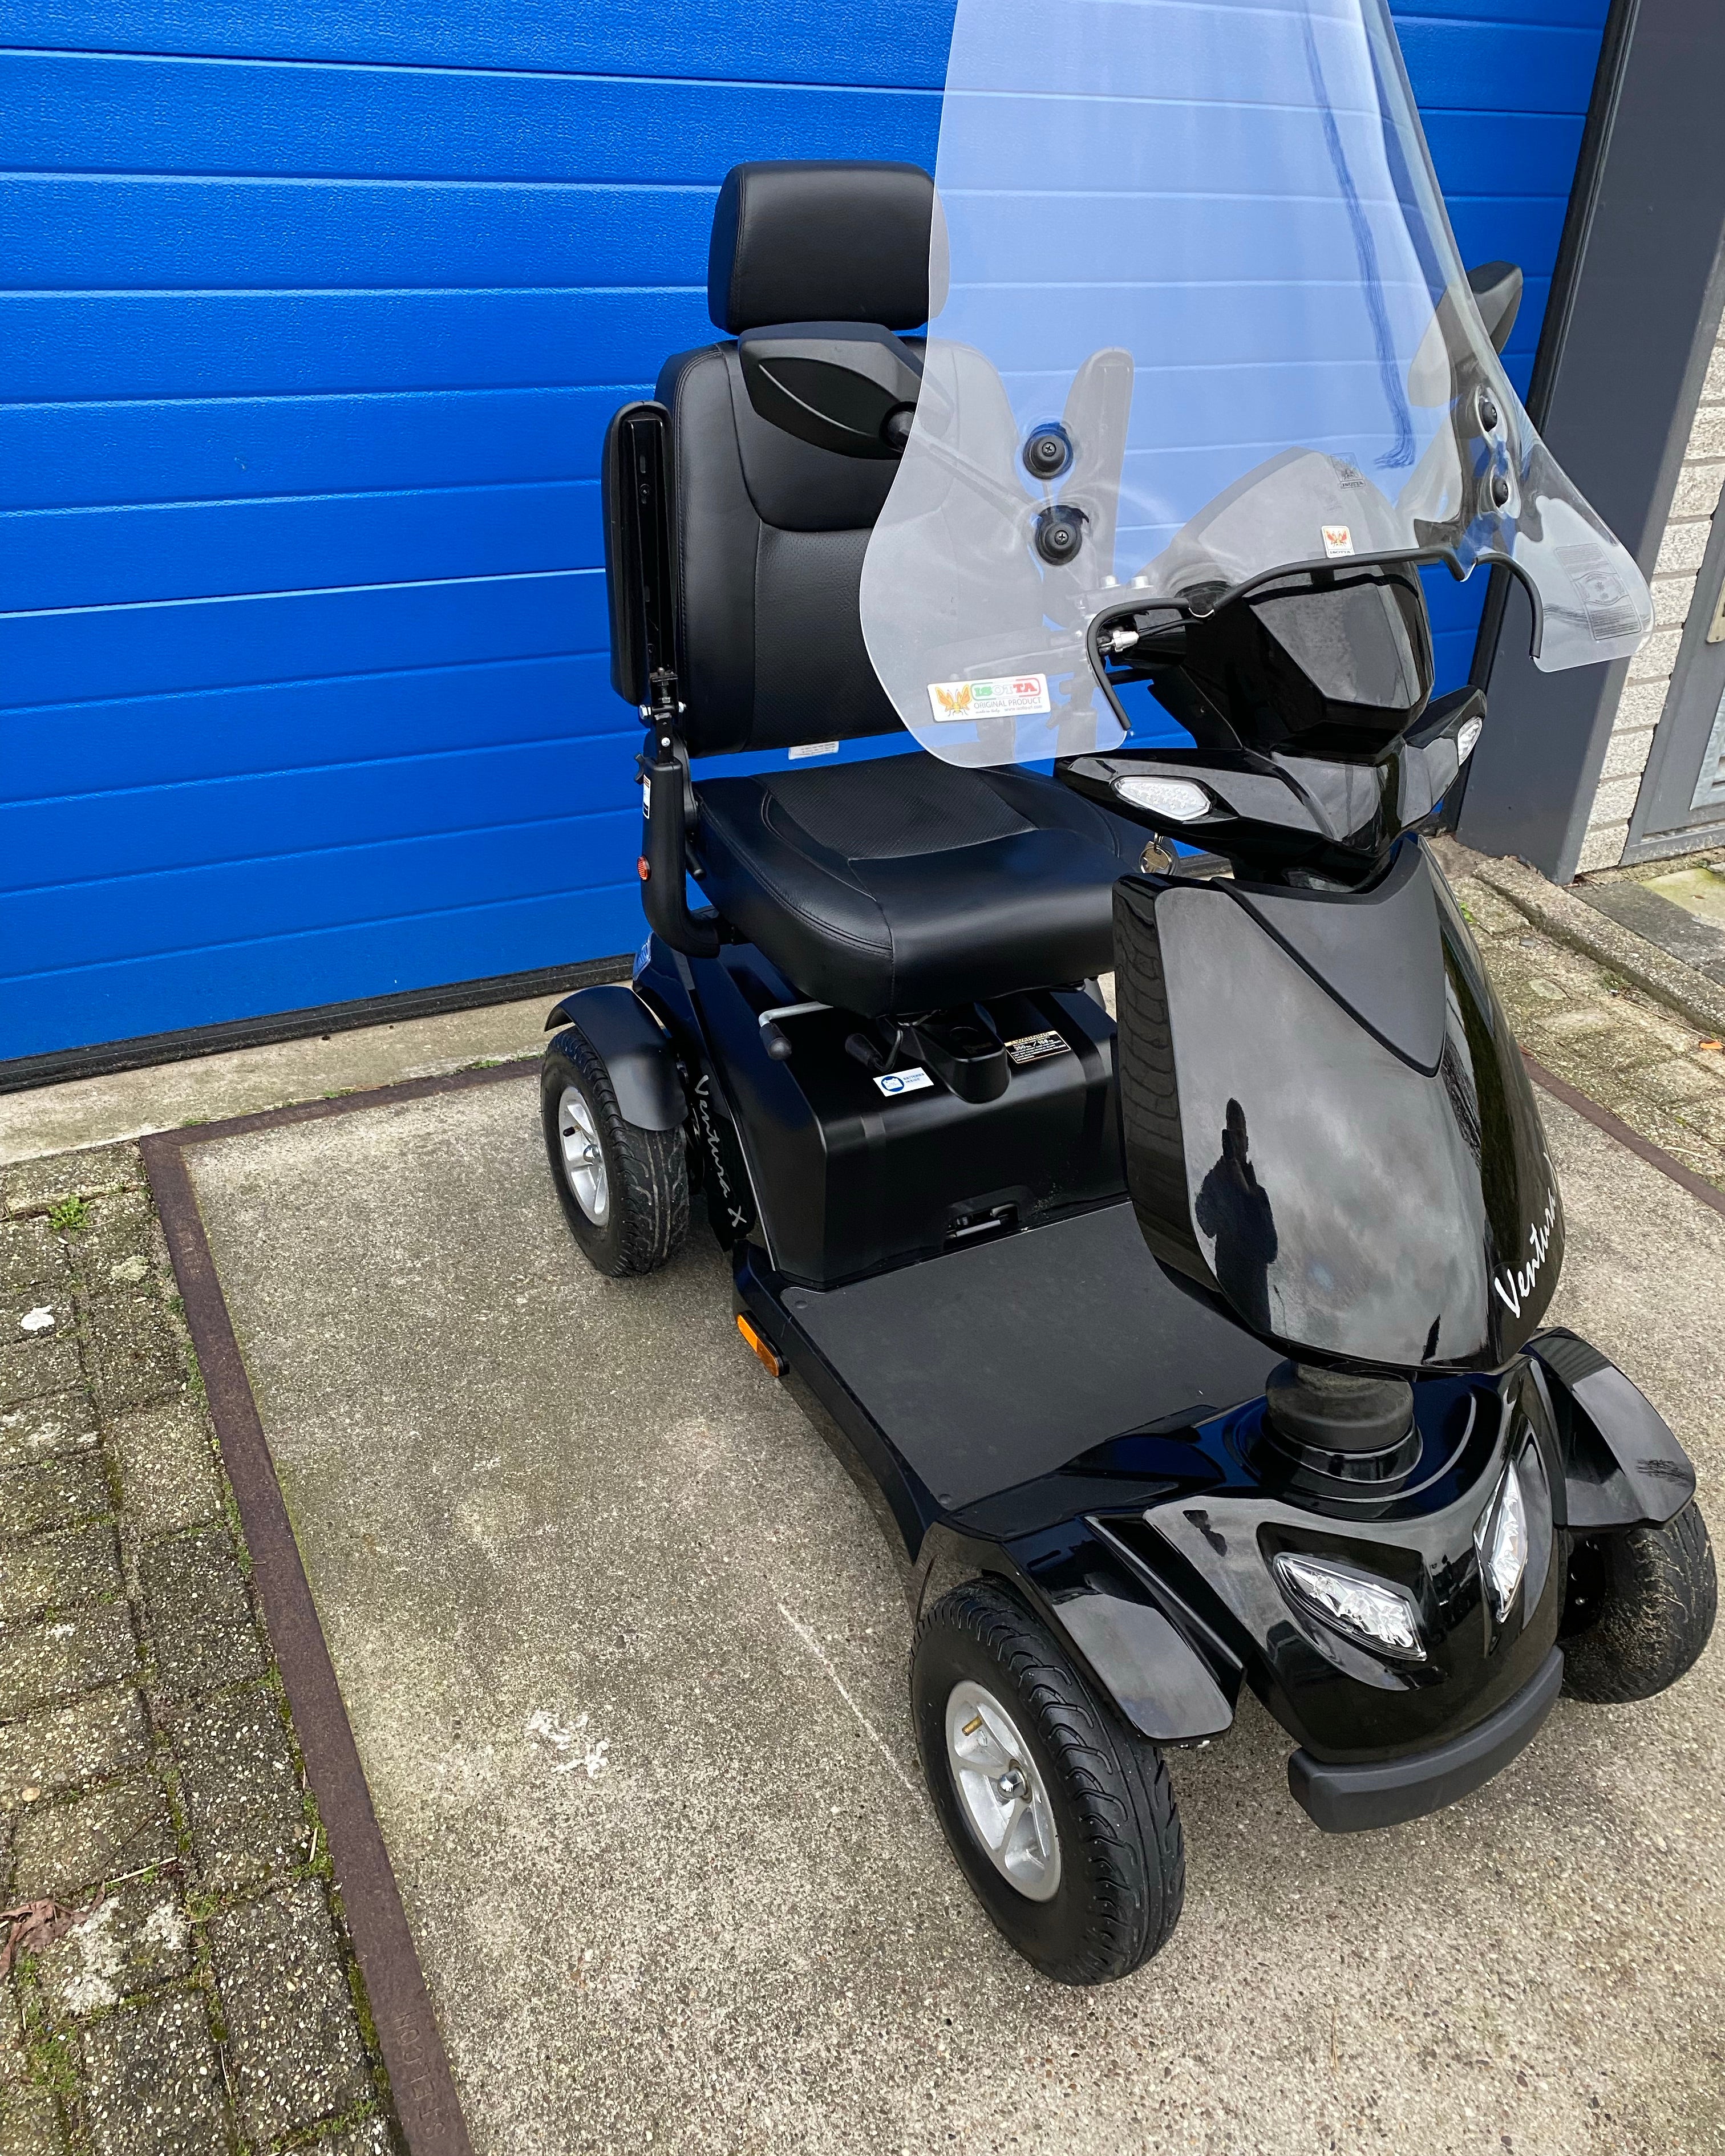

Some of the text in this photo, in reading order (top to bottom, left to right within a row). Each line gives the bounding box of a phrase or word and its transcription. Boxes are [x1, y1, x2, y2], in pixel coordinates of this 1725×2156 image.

[974, 683, 1037, 697] ISOTTA
[974, 697, 1042, 709] ORIGINAL PRODUCT
[695, 1075, 747, 1227] Ventura X
